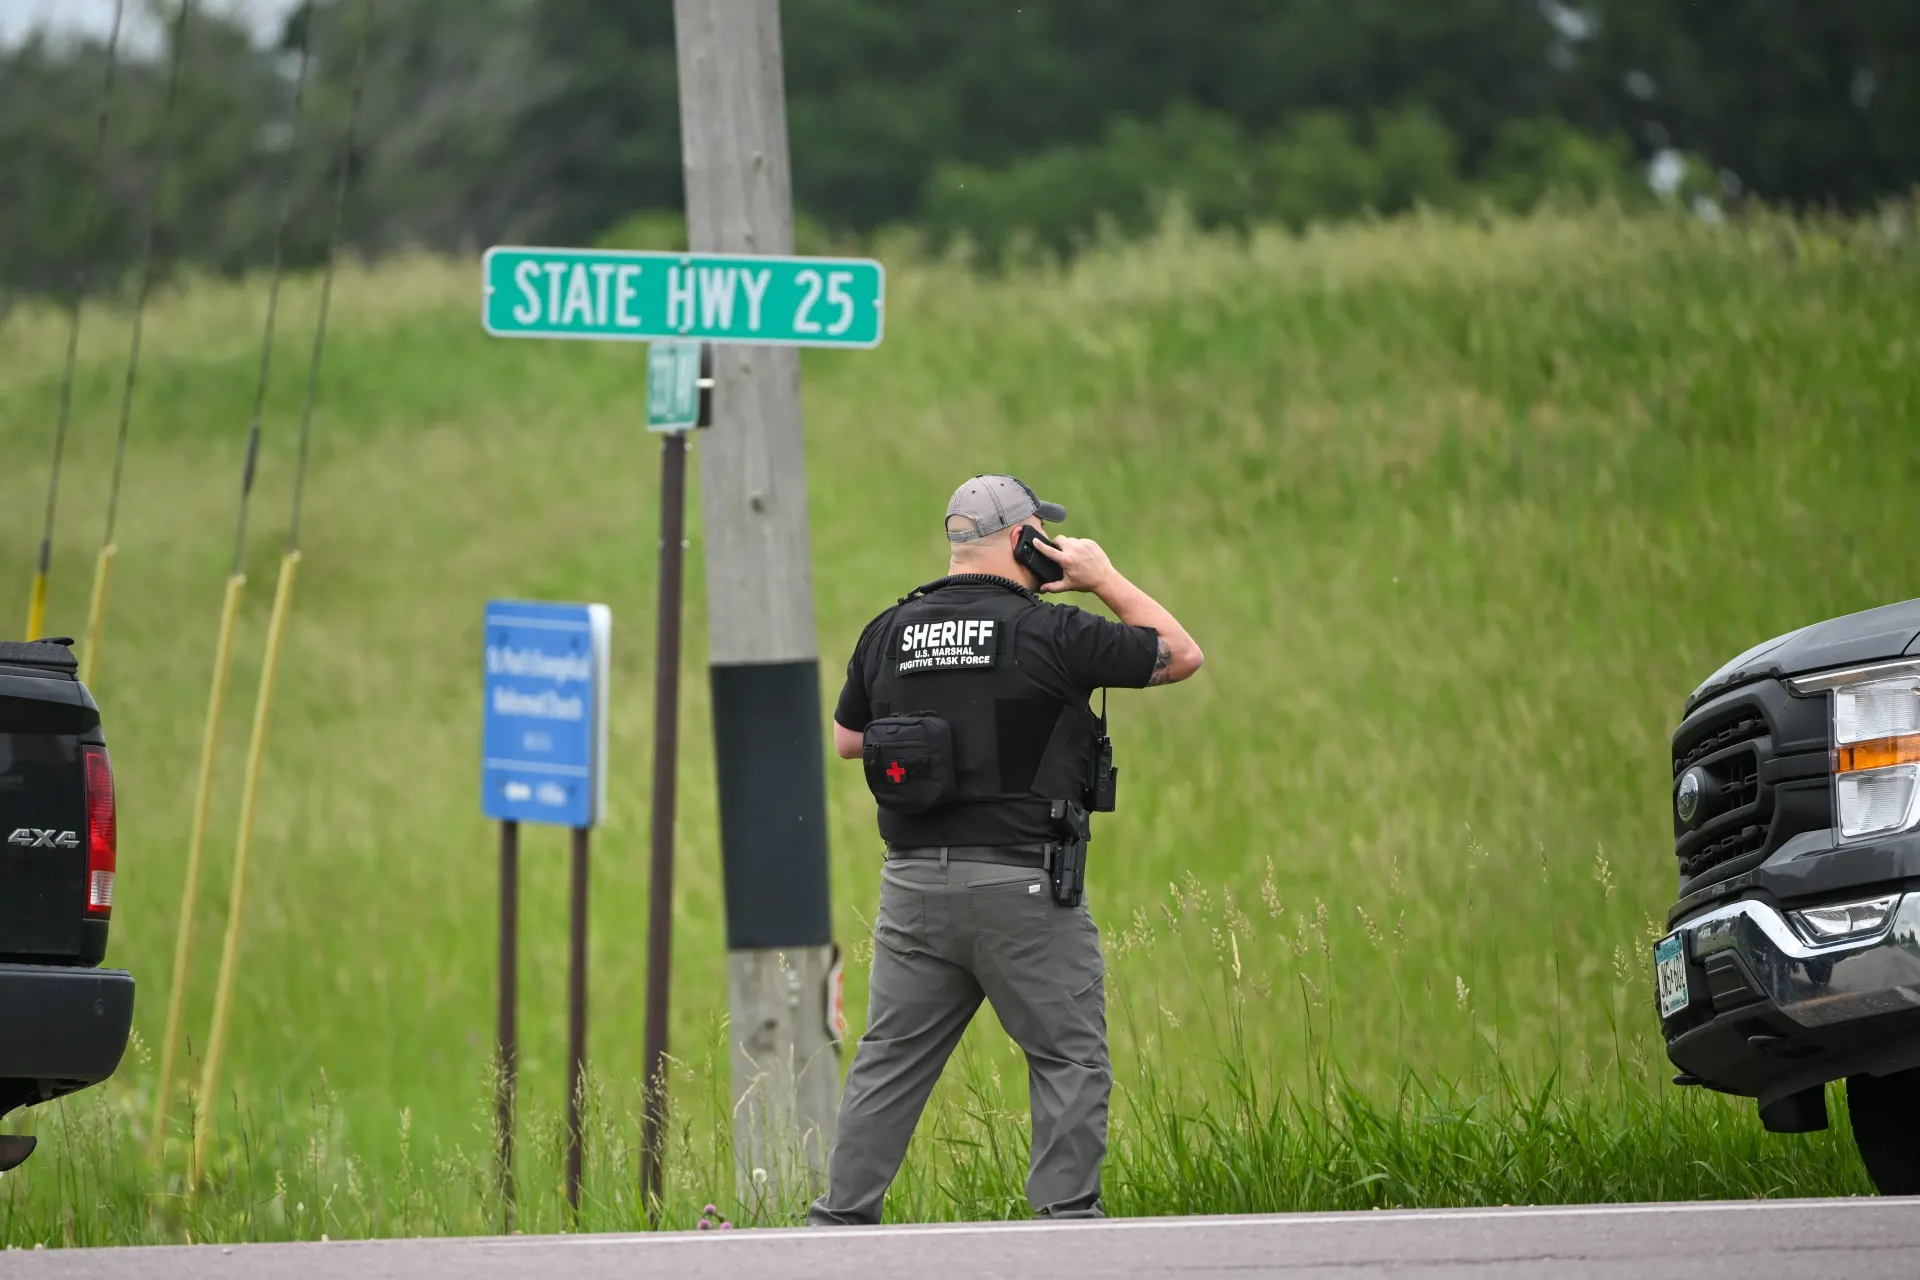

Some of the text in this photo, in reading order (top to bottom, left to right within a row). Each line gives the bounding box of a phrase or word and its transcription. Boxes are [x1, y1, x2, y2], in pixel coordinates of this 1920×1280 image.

[513, 260, 854, 335] STATE HWY 25
[902, 620, 994, 652] SHERIFF
[900, 656, 990, 672] FUGITIVE TASK FORCE
[915, 647, 974, 658] U.S. MARSHAL
